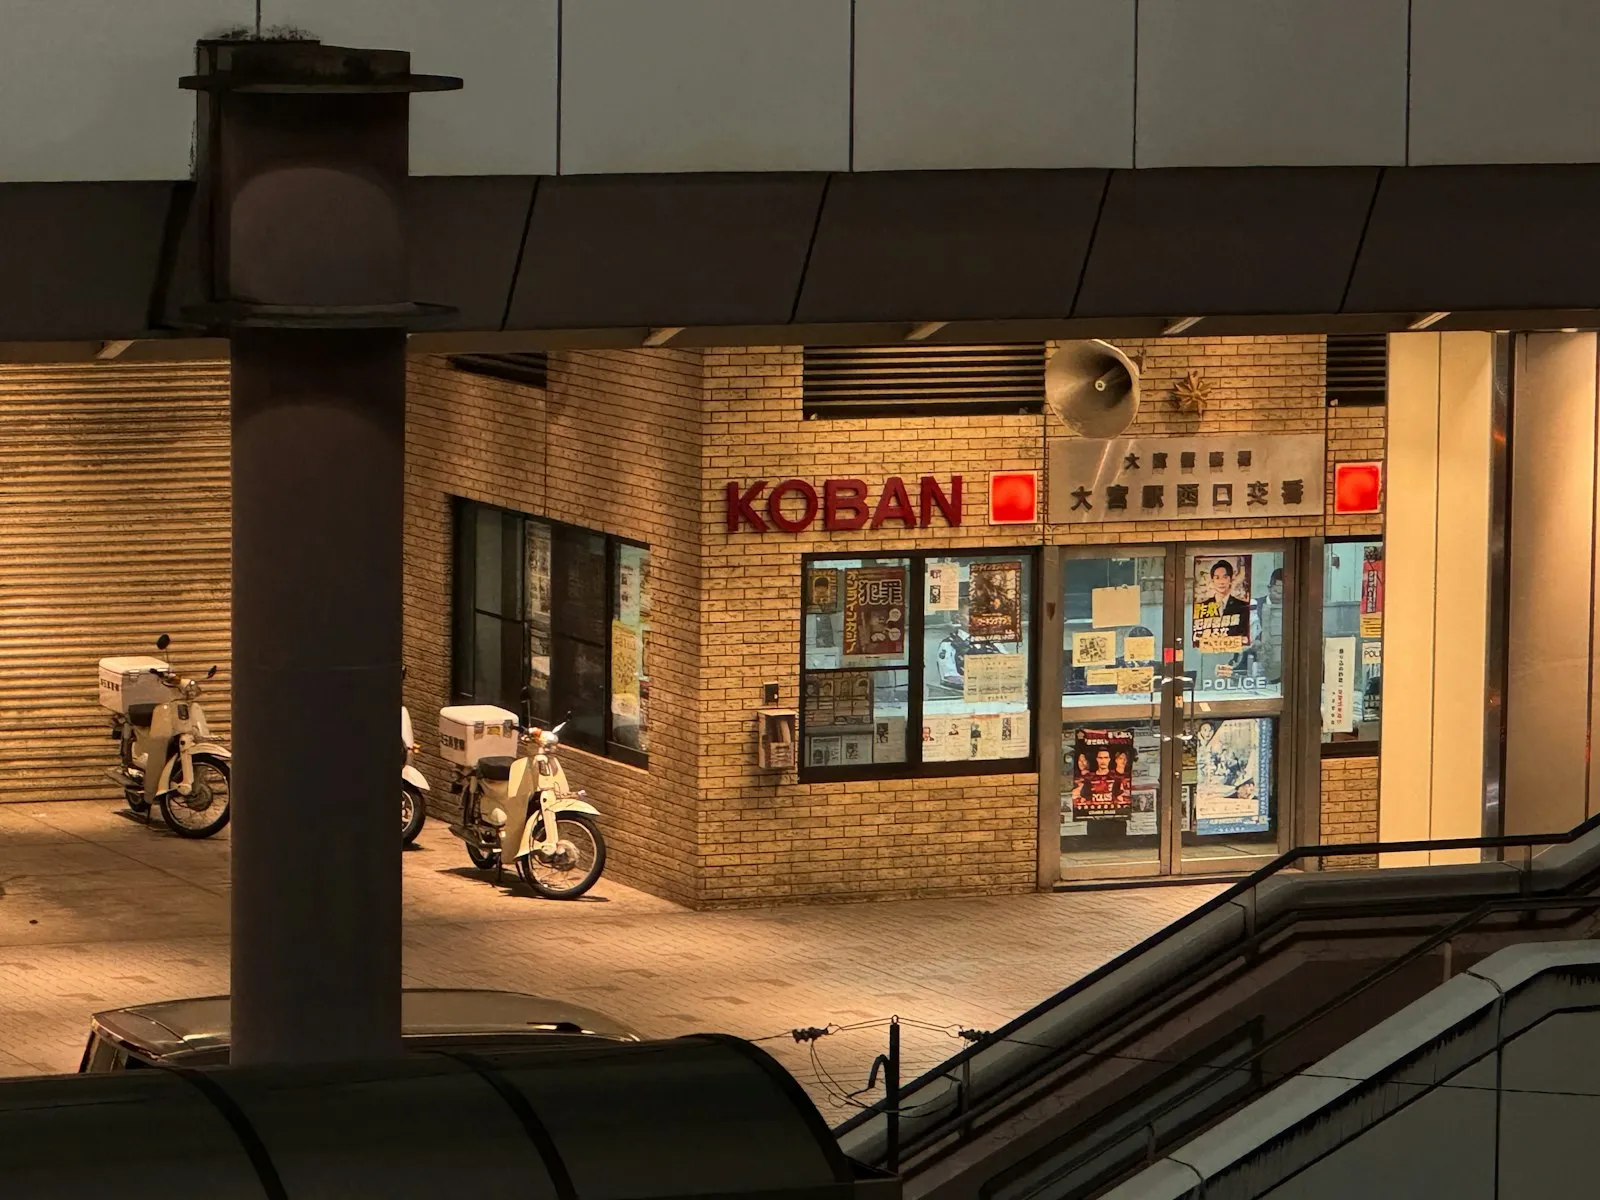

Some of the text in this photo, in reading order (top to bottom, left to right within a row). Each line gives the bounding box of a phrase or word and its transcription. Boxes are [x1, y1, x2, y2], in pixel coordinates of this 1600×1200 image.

[726, 475, 962, 533] KOBAN
[857, 578, 904, 606] 犯罪
[1202, 676, 1267, 691] POLICE
